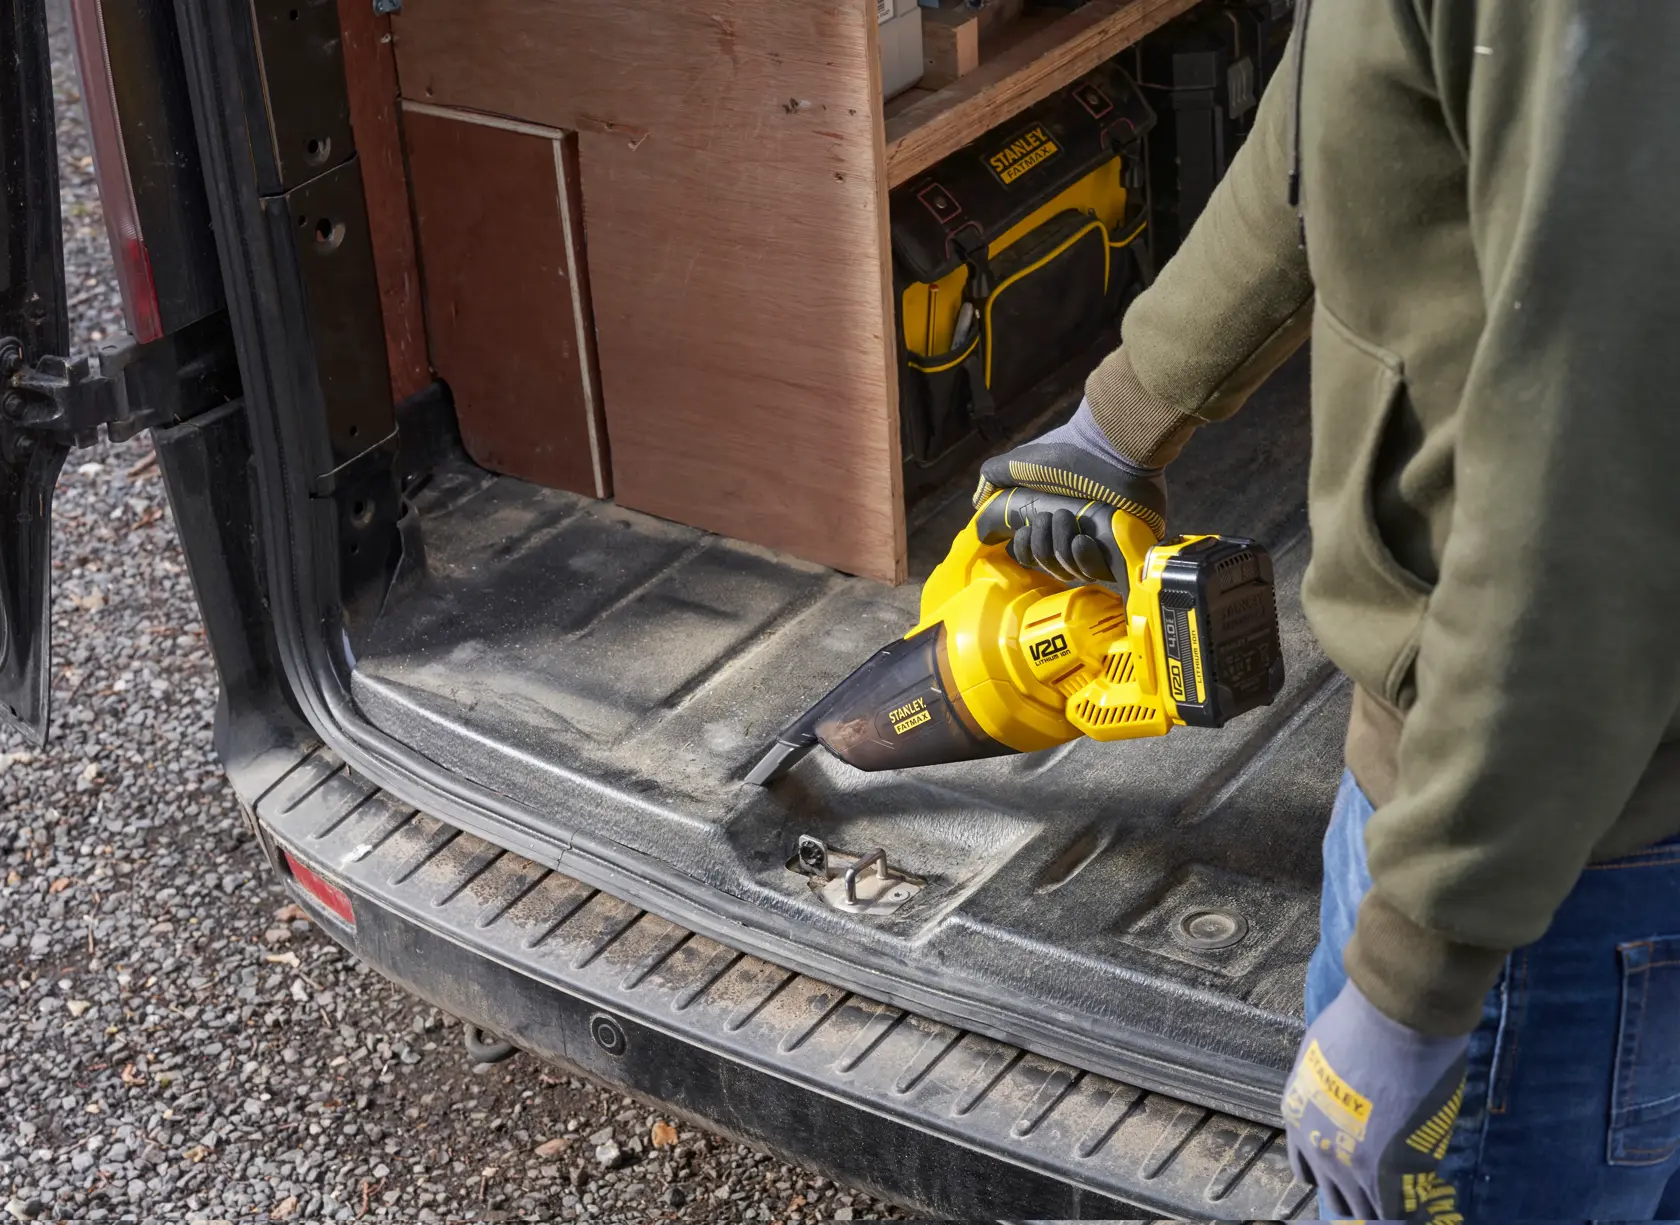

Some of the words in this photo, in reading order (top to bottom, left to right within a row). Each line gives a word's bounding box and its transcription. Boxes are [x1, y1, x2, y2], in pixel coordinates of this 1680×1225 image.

[990, 128, 1048, 172] STANLEY
[1007, 146, 1050, 179] FATMAX
[1029, 634, 1068, 661] V20
[1034, 653, 1060, 667] LITHIUM
[1171, 665, 1184, 696] V20
[1193, 647, 1203, 684] LITHIUM
[888, 697, 927, 723] STANLEY
[896, 712, 929, 732] FATMAX
[1308, 1048, 1365, 1114] STANLEY
